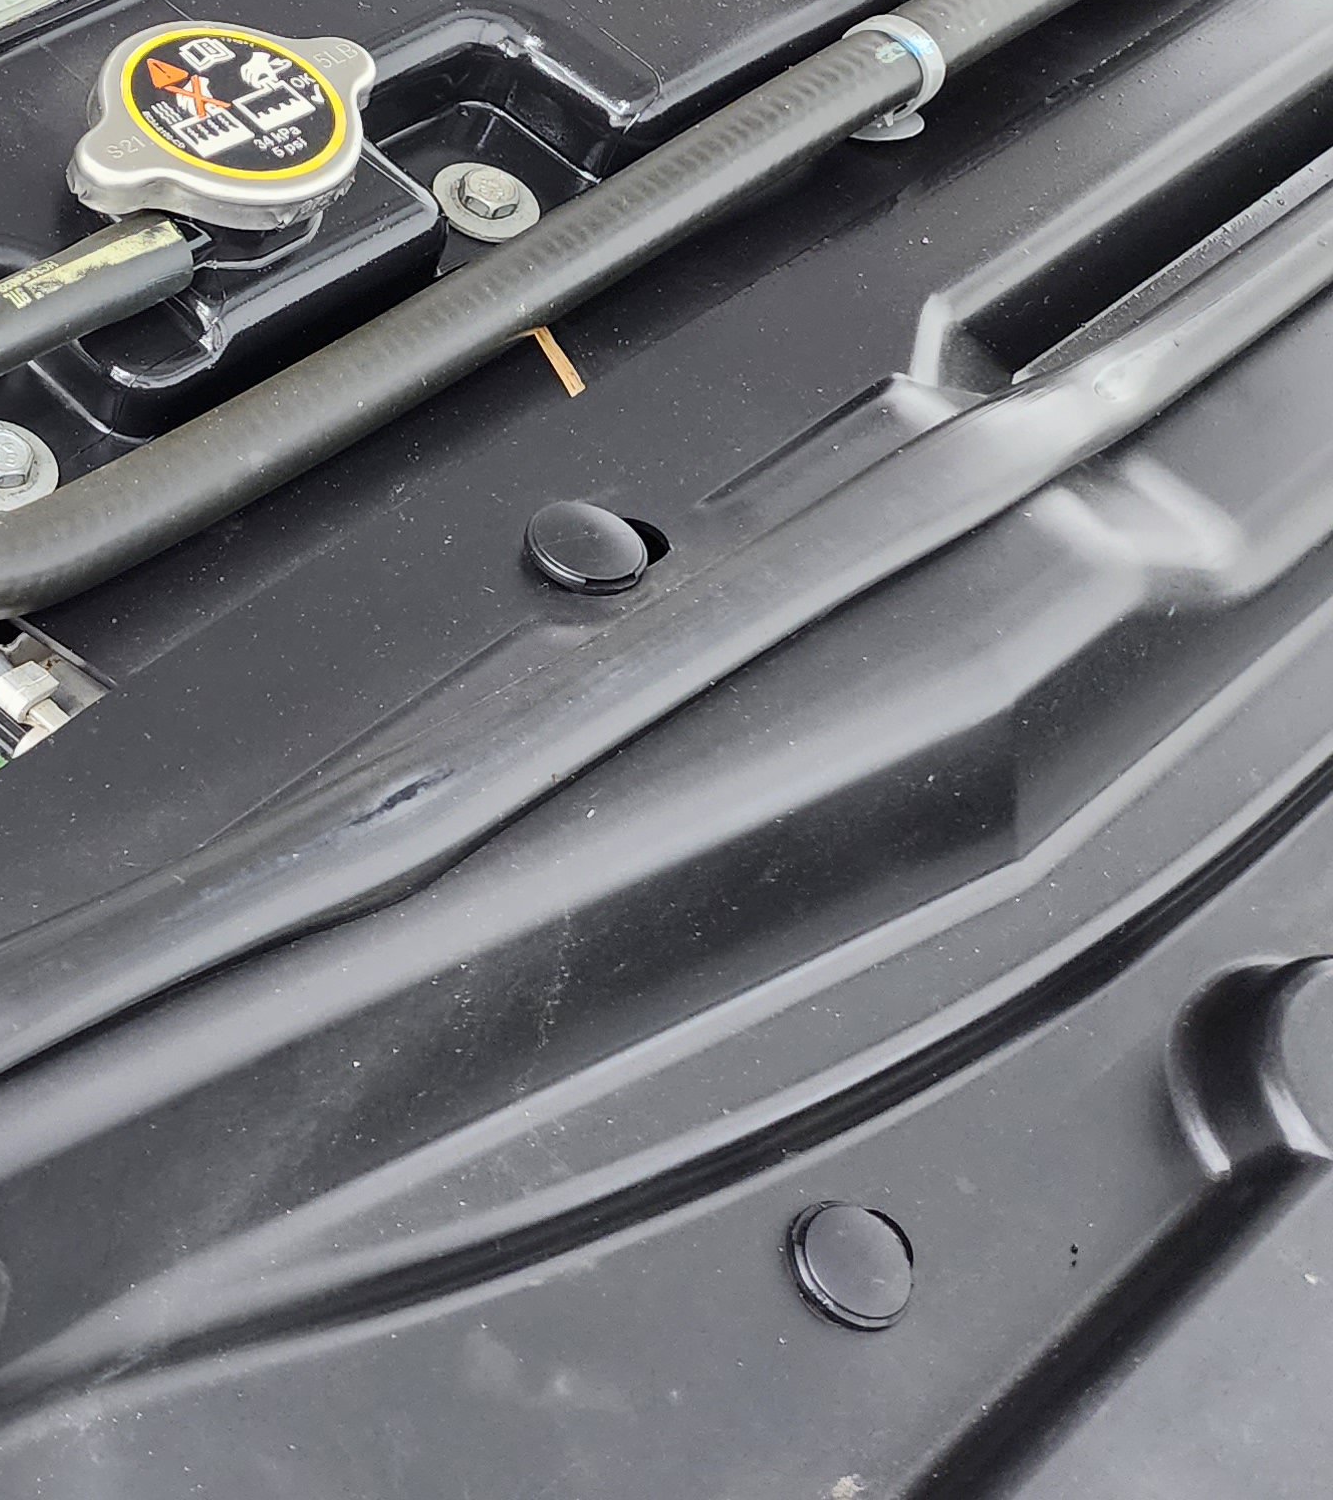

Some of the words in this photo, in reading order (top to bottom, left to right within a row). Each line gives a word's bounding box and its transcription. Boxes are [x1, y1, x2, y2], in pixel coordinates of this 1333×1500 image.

[312, 42, 359, 68] 5LB
[290, 72, 317, 90] OK
[253, 136, 274, 152] 34
[275, 124, 301, 143] kPa
[272, 145, 284, 158] 5
[285, 138, 309, 156] psi
